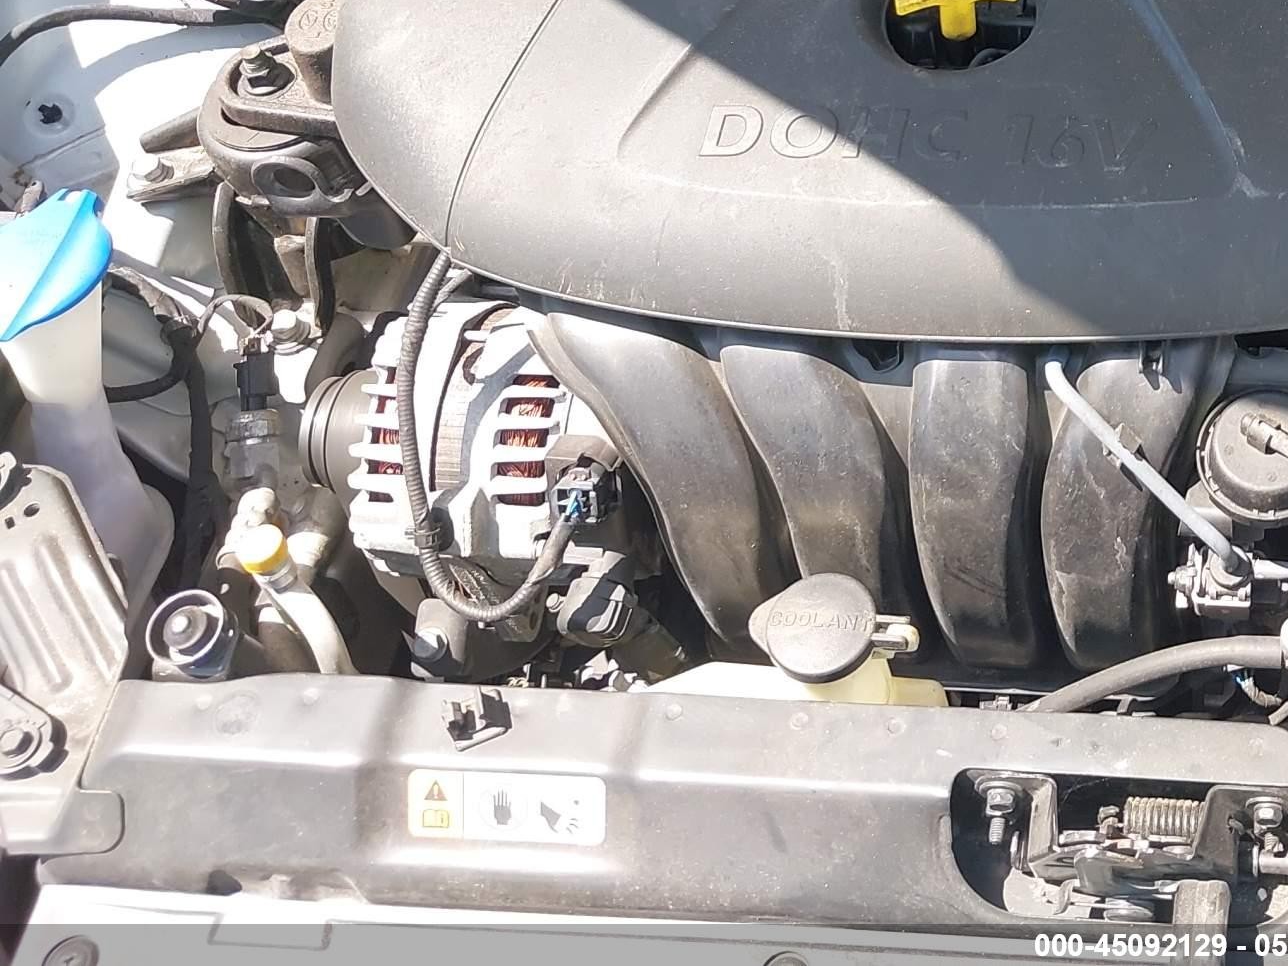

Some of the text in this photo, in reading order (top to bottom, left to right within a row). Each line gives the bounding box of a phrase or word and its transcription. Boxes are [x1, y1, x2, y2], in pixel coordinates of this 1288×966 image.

[697, 103, 1159, 172] DOHC 16V
[769, 609, 873, 632] COOLANT
